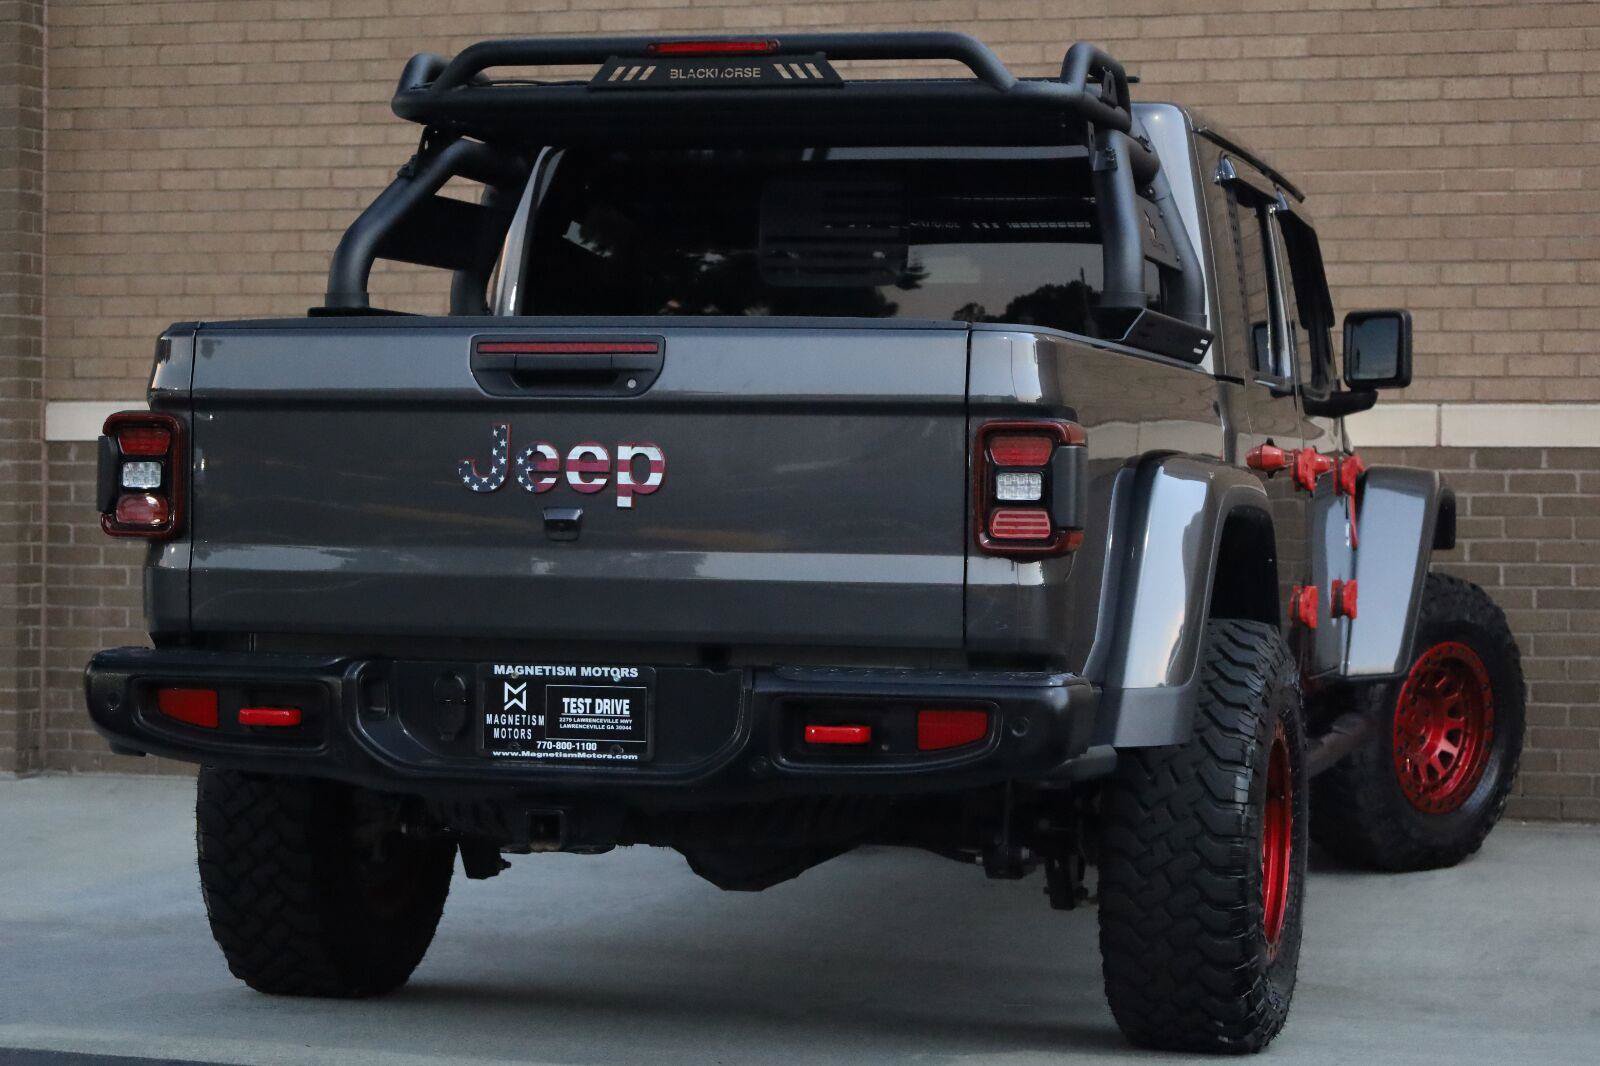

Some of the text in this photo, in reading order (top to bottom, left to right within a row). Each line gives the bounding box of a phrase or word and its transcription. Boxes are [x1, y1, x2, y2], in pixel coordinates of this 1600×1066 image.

[457, 422, 665, 508] Jeep
[493, 664, 639, 678] MAGNETISM MOTORS
[562, 697, 630, 715] TEST DRIVE
[486, 713, 545, 726] MAGNETISM
[493, 727, 532, 740] MOTORS
[536, 741, 597, 751] 770-800-1100
[493, 750, 638, 760] www.MagnetismMotors.com
